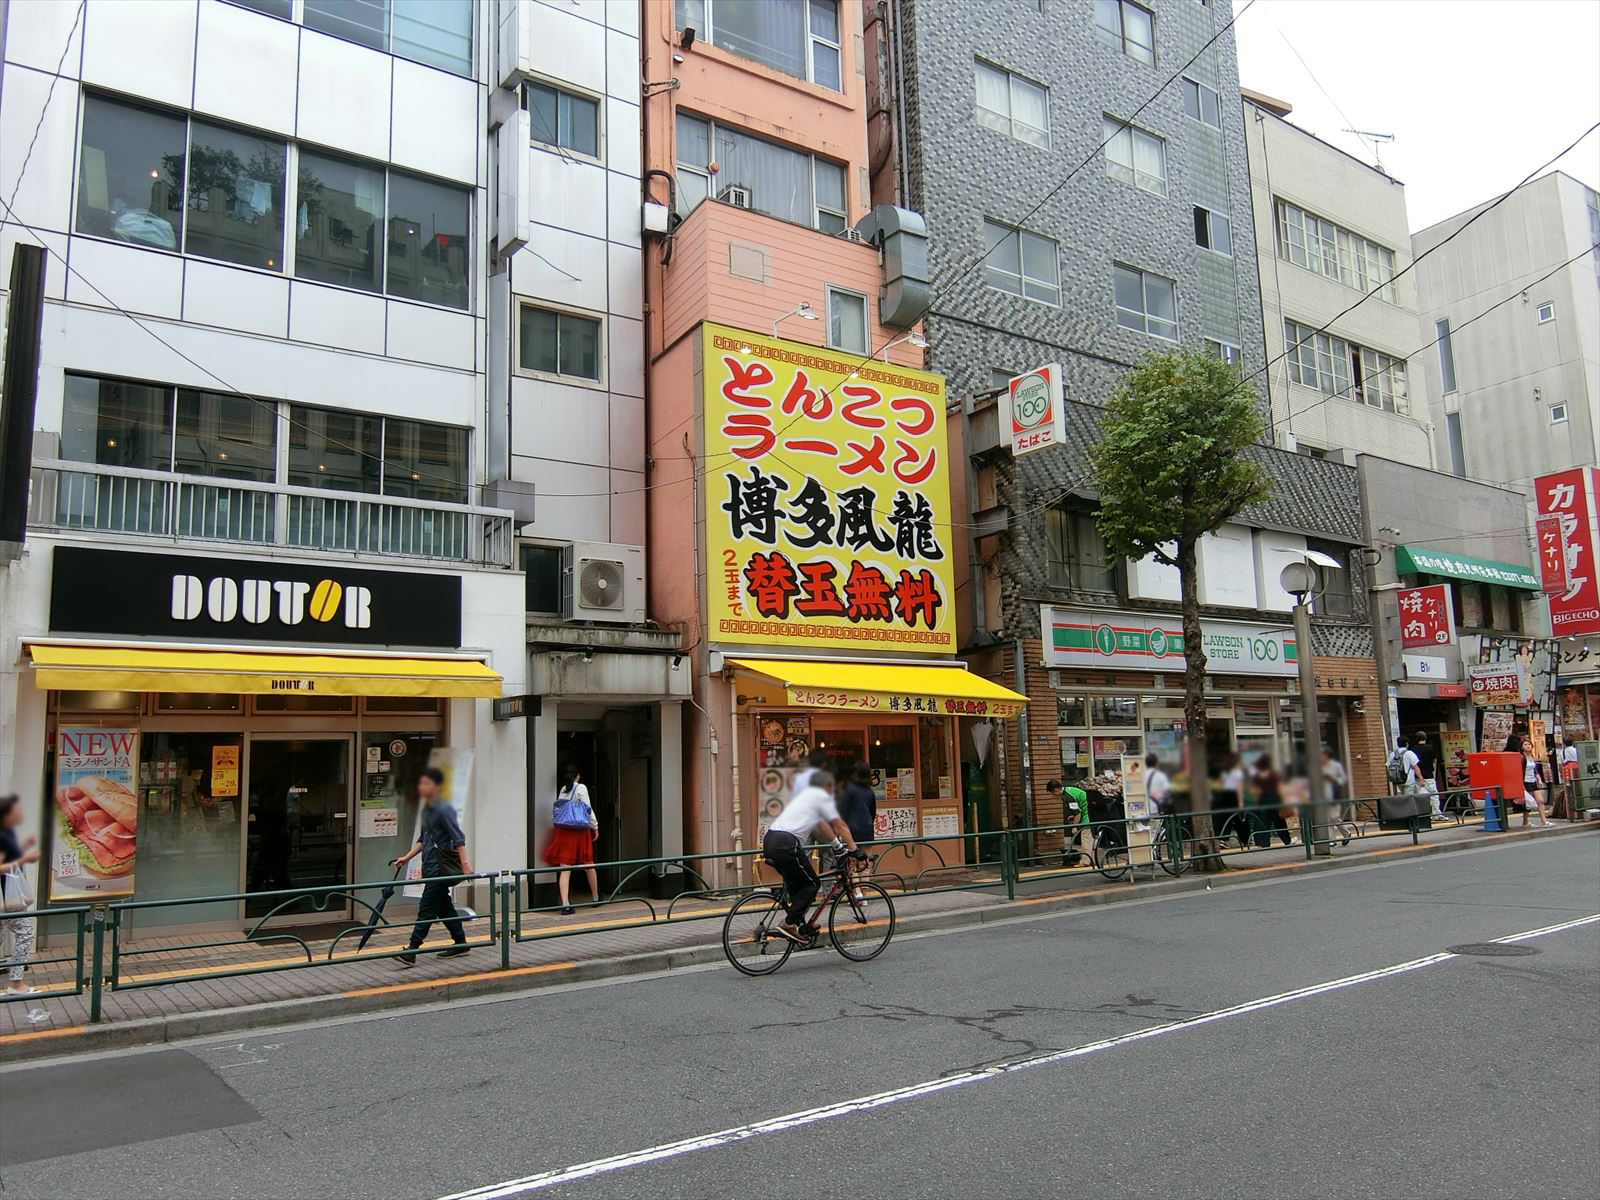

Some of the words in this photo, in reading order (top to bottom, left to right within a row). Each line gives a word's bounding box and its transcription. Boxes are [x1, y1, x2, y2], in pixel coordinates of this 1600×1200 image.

[723, 358, 935, 435] とんこつ
[1017, 382, 1044, 399] LAWSON
[1017, 396, 1047, 421] 100
[723, 414, 936, 484] ラーメン
[1018, 430, 1052, 449] たばこ
[722, 466, 944, 559] 博多風龍
[722, 549, 743, 616] 2玉まで
[743, 551, 942, 630] 替玉無料
[171, 574, 371, 629] DOUTOR
[1426, 597, 1438, 630] ケナリ
[1400, 591, 1426, 638] 焼肉
[1552, 613, 1571, 624] BIG
[1572, 609, 1600, 620] ECHO
[1122, 635, 1141, 648] 野菜
[1202, 634, 1244, 648] LAWSON
[1247, 637, 1279, 661] 100
[1437, 633, 1446, 641] 2F
[1209, 648, 1240, 660] STORE
[271, 679, 315, 691] DOUTOR
[1484, 675, 1512, 690] 焼肉
[795, 690, 880, 708] とんこつラーメン
[888, 695, 939, 713] 博多風龍
[992, 703, 1021, 715] 2玉まで
[58, 732, 139, 757] NEW
[64, 757, 131, 768] ミラノサンドA
